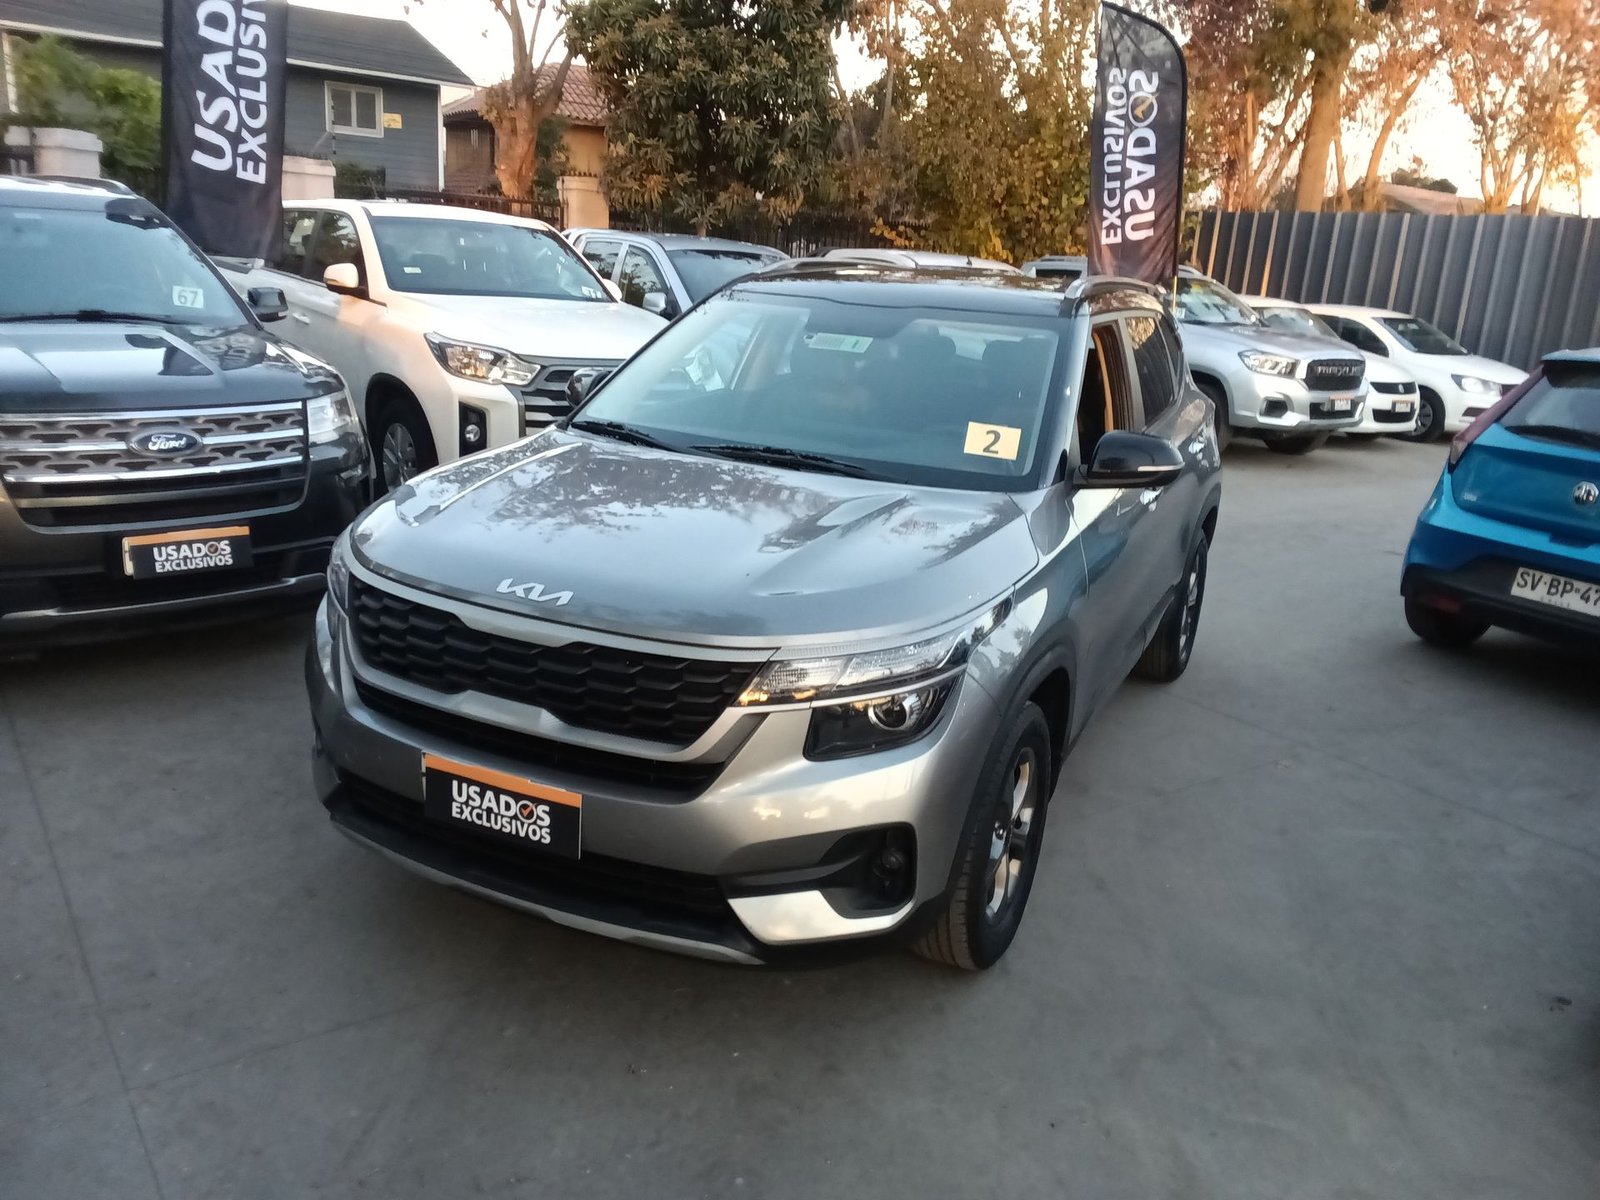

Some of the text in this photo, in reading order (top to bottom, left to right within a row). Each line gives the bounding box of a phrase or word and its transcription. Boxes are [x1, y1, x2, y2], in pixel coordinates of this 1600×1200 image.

[236, 0, 267, 184] EXCLUSI
[177, 289, 198, 306] 67
[147, 433, 187, 451] Ford
[982, 429, 1001, 454] 2
[152, 540, 231, 561] USADOS
[154, 554, 233, 573] EXCLUSIVOS
[451, 779, 551, 827] USADOS
[451, 801, 552, 845] EXCLUSIVOS
